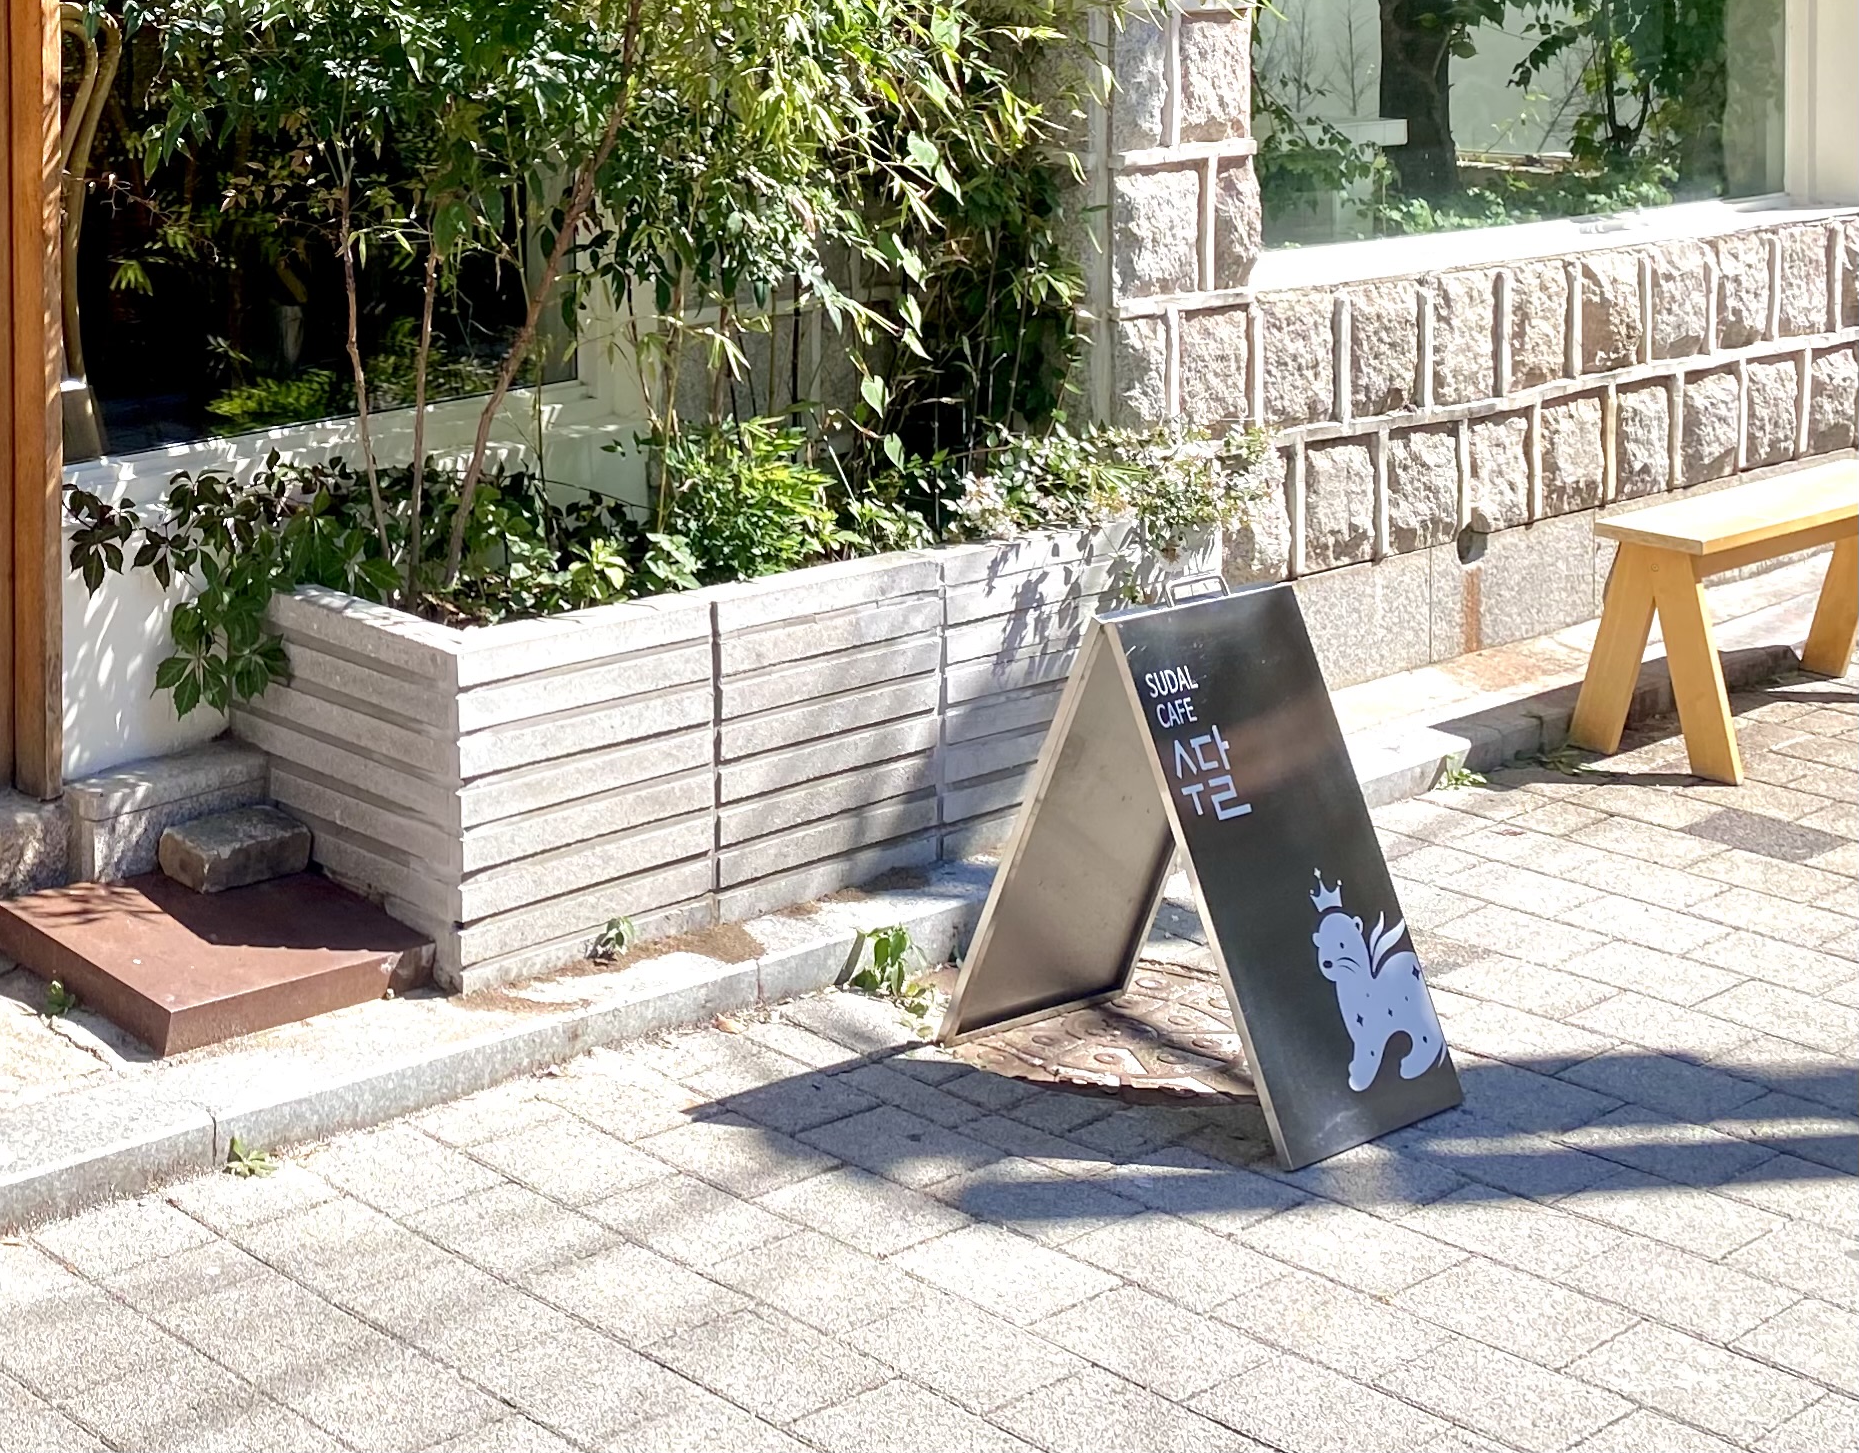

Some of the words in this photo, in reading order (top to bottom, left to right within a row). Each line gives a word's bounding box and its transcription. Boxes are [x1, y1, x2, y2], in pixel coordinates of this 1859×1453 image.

[1145, 665, 1199, 698] SUDAL
[1156, 697, 1198, 728] CAFE
[1173, 724, 1252, 821] 수달
